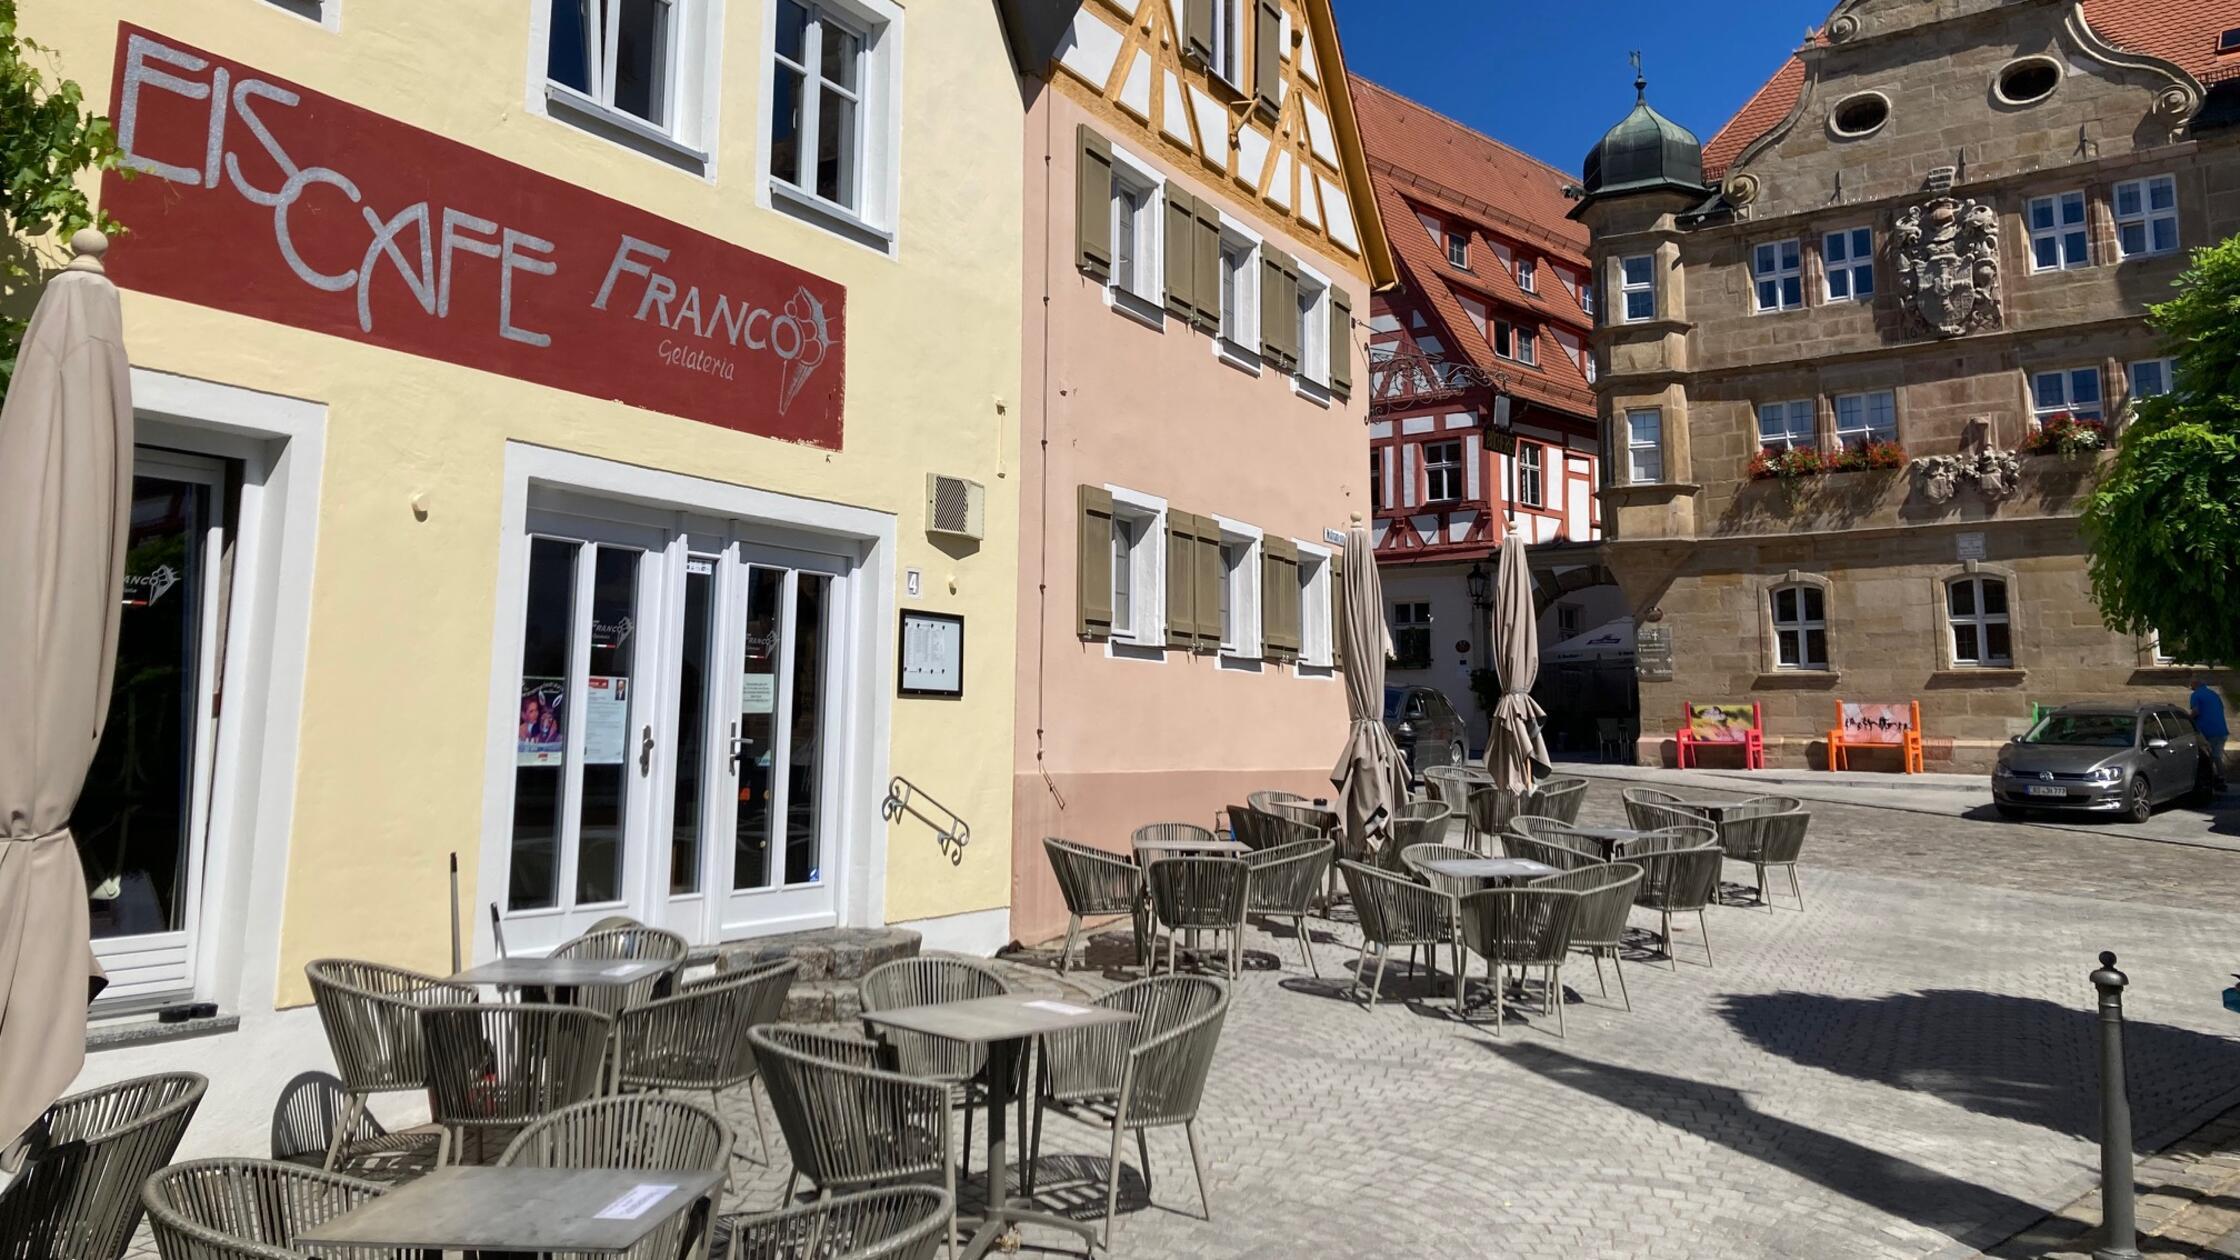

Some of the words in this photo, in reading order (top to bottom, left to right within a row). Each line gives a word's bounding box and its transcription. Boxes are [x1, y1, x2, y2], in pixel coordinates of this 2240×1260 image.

[590, 234, 805, 361] FRANCO
[658, 339, 736, 381] Gelateria
[909, 573, 918, 593] 4
